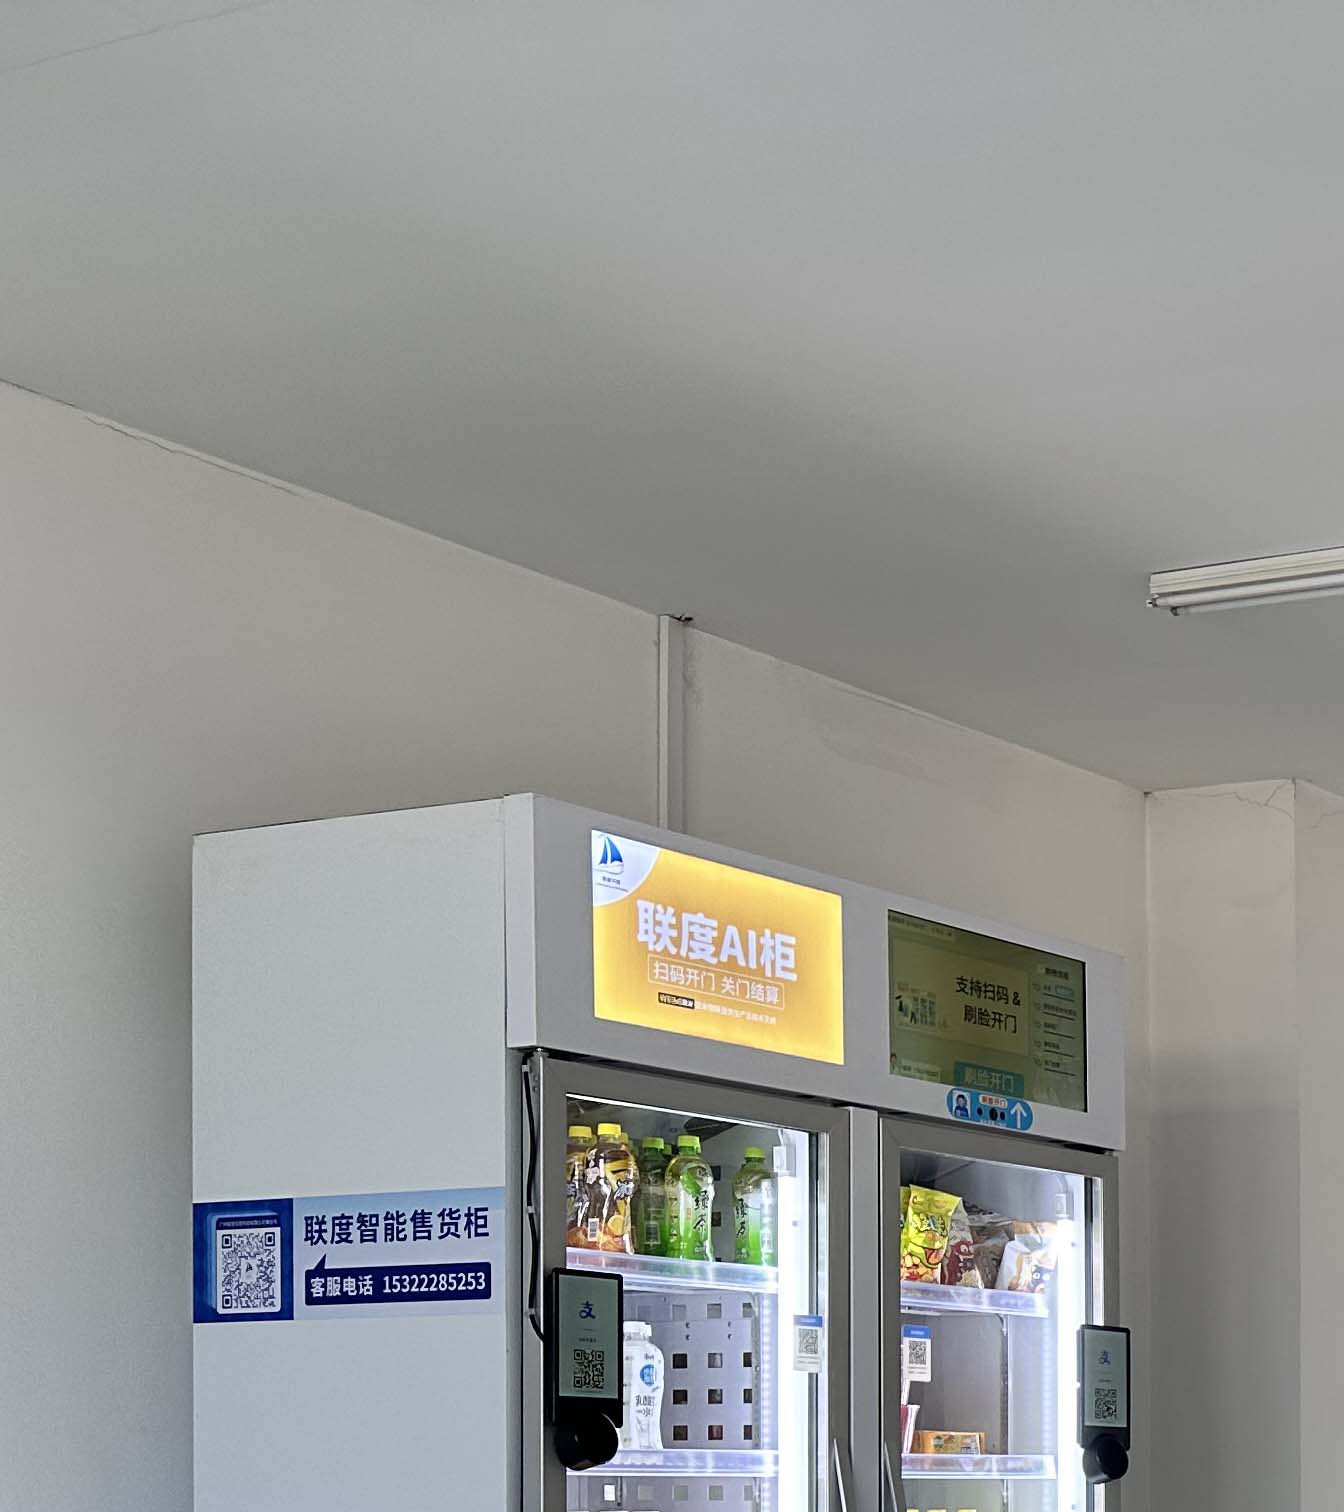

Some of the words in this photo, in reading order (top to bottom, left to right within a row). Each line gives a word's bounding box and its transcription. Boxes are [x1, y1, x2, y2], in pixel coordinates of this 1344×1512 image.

[636, 899, 798, 982] 联度AI柜
[653, 960, 715, 992] 扫码开门
[720, 974, 780, 1005] 关门结算
[955, 975, 1009, 1006] 支持扫码
[1012, 991, 1021, 1006] &
[964, 1004, 1018, 1035] 刷脸开门
[303, 1206, 491, 1247] 联度智能售货柜
[309, 1273, 374, 1298] 客服电话
[382, 1271, 487, 1295] 15322285253
